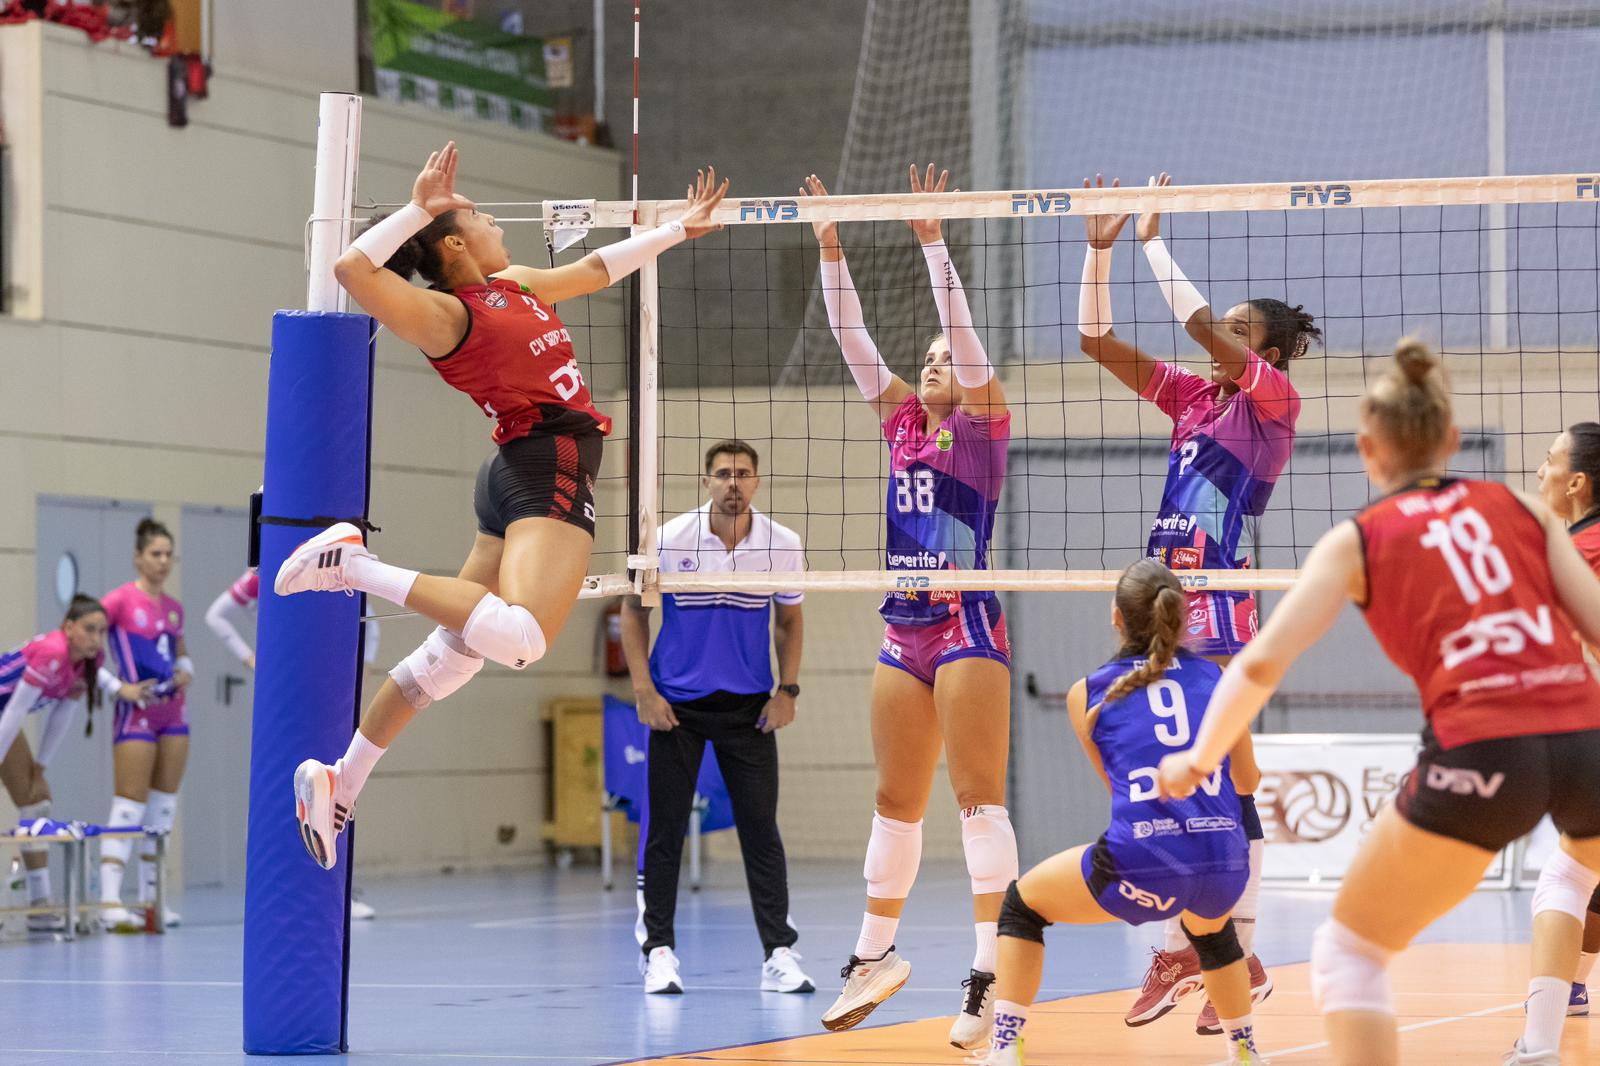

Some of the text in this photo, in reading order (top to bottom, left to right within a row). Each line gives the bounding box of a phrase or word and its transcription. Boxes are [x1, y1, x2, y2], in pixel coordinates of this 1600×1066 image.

[521, 294, 549, 321] 3
[529, 338, 547, 357] CV
[894, 469, 934, 513] 88
[1420, 506, 1513, 605] 18
[1440, 604, 1555, 671] DSV
[1146, 678, 1191, 746] 9
[1127, 765, 1223, 803] DV
[1426, 763, 1506, 798] DSV
[1118, 879, 1177, 911] DSV
